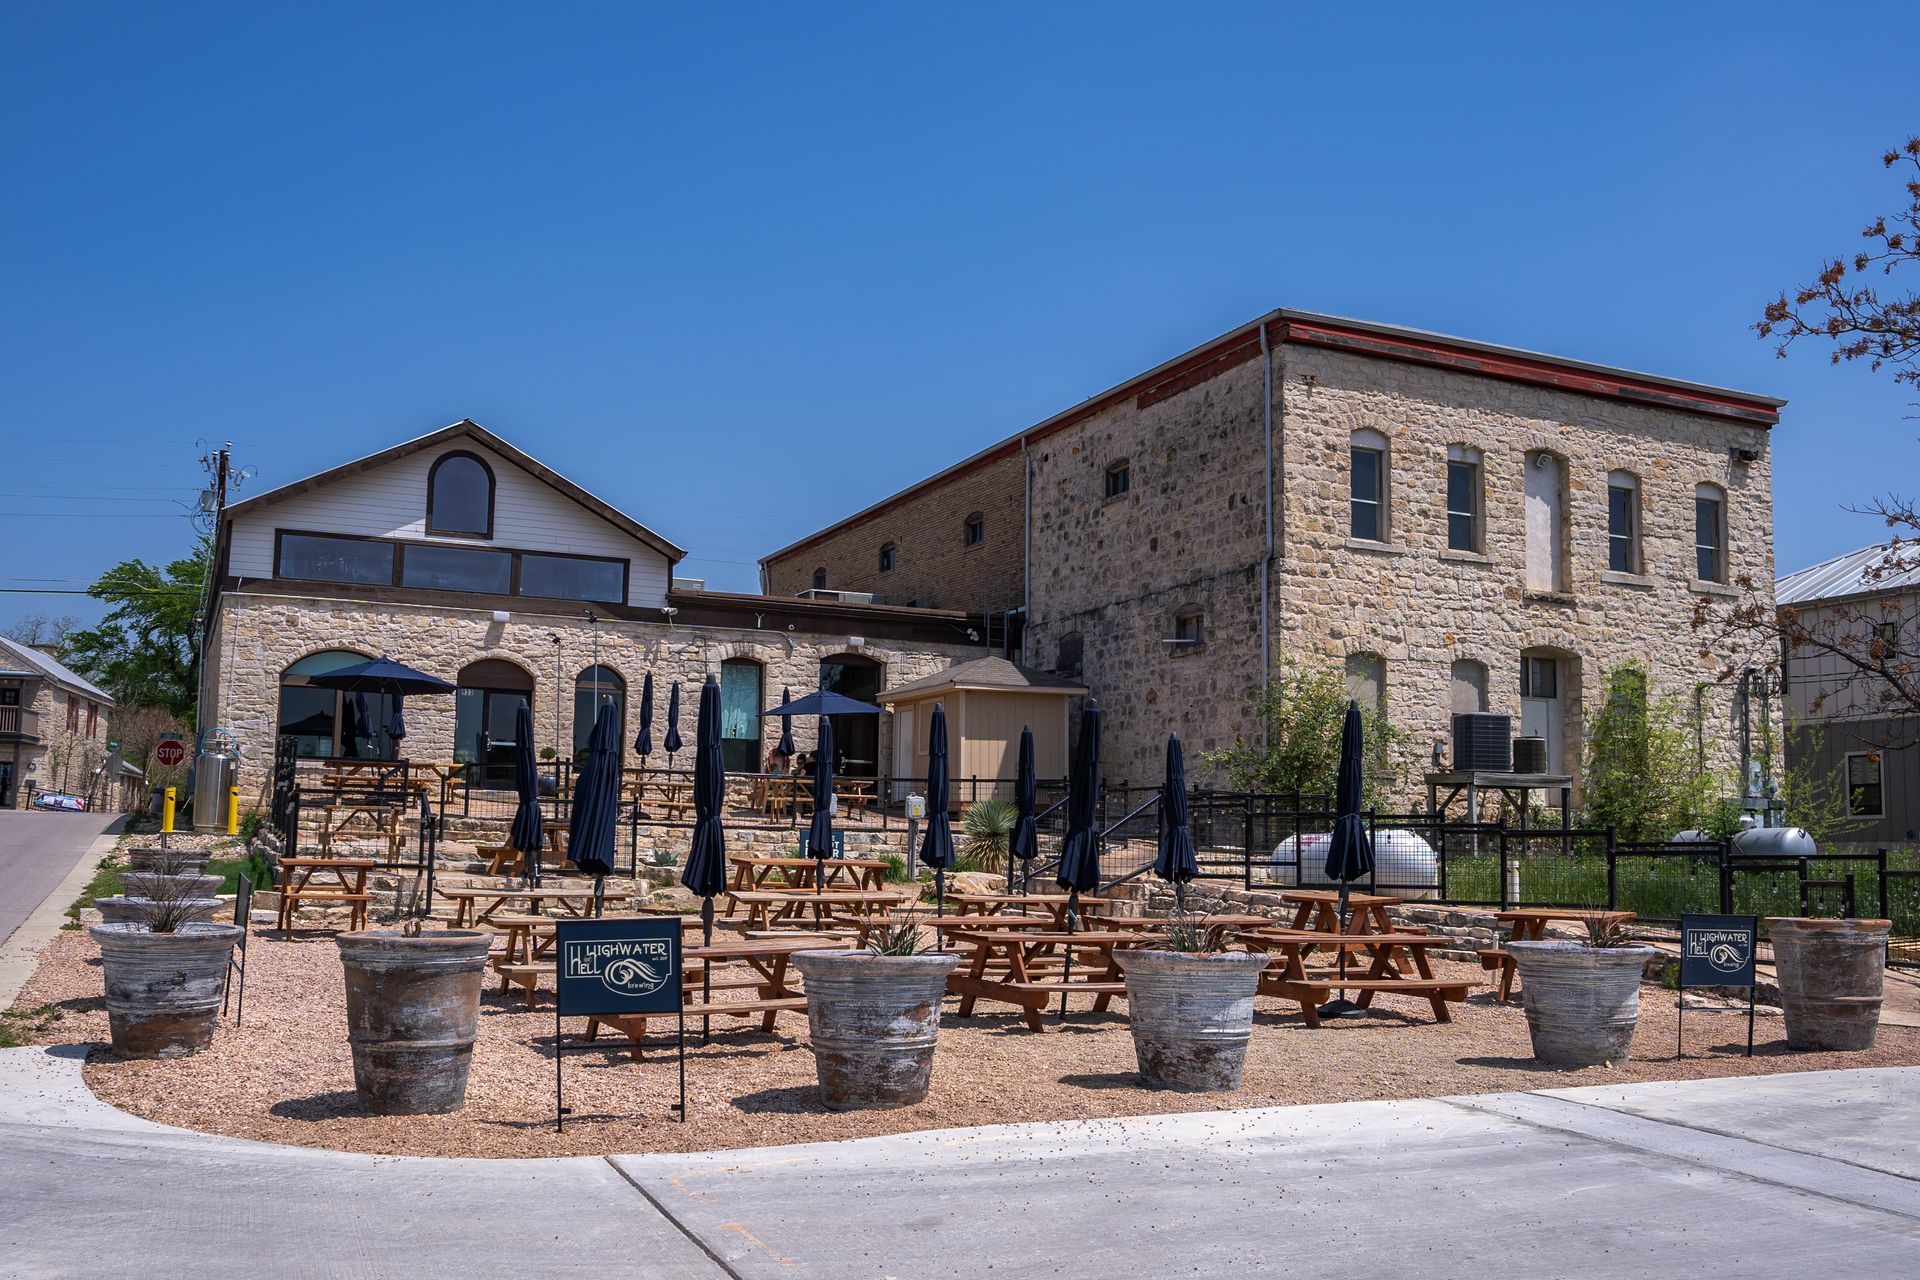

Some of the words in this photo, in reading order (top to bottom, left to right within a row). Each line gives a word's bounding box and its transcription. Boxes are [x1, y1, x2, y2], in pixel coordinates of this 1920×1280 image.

[159, 747, 183, 758] STOP
[570, 945, 601, 975] HELL
[586, 942, 668, 957] HIGHWATER
[627, 982, 655, 990] brewing
